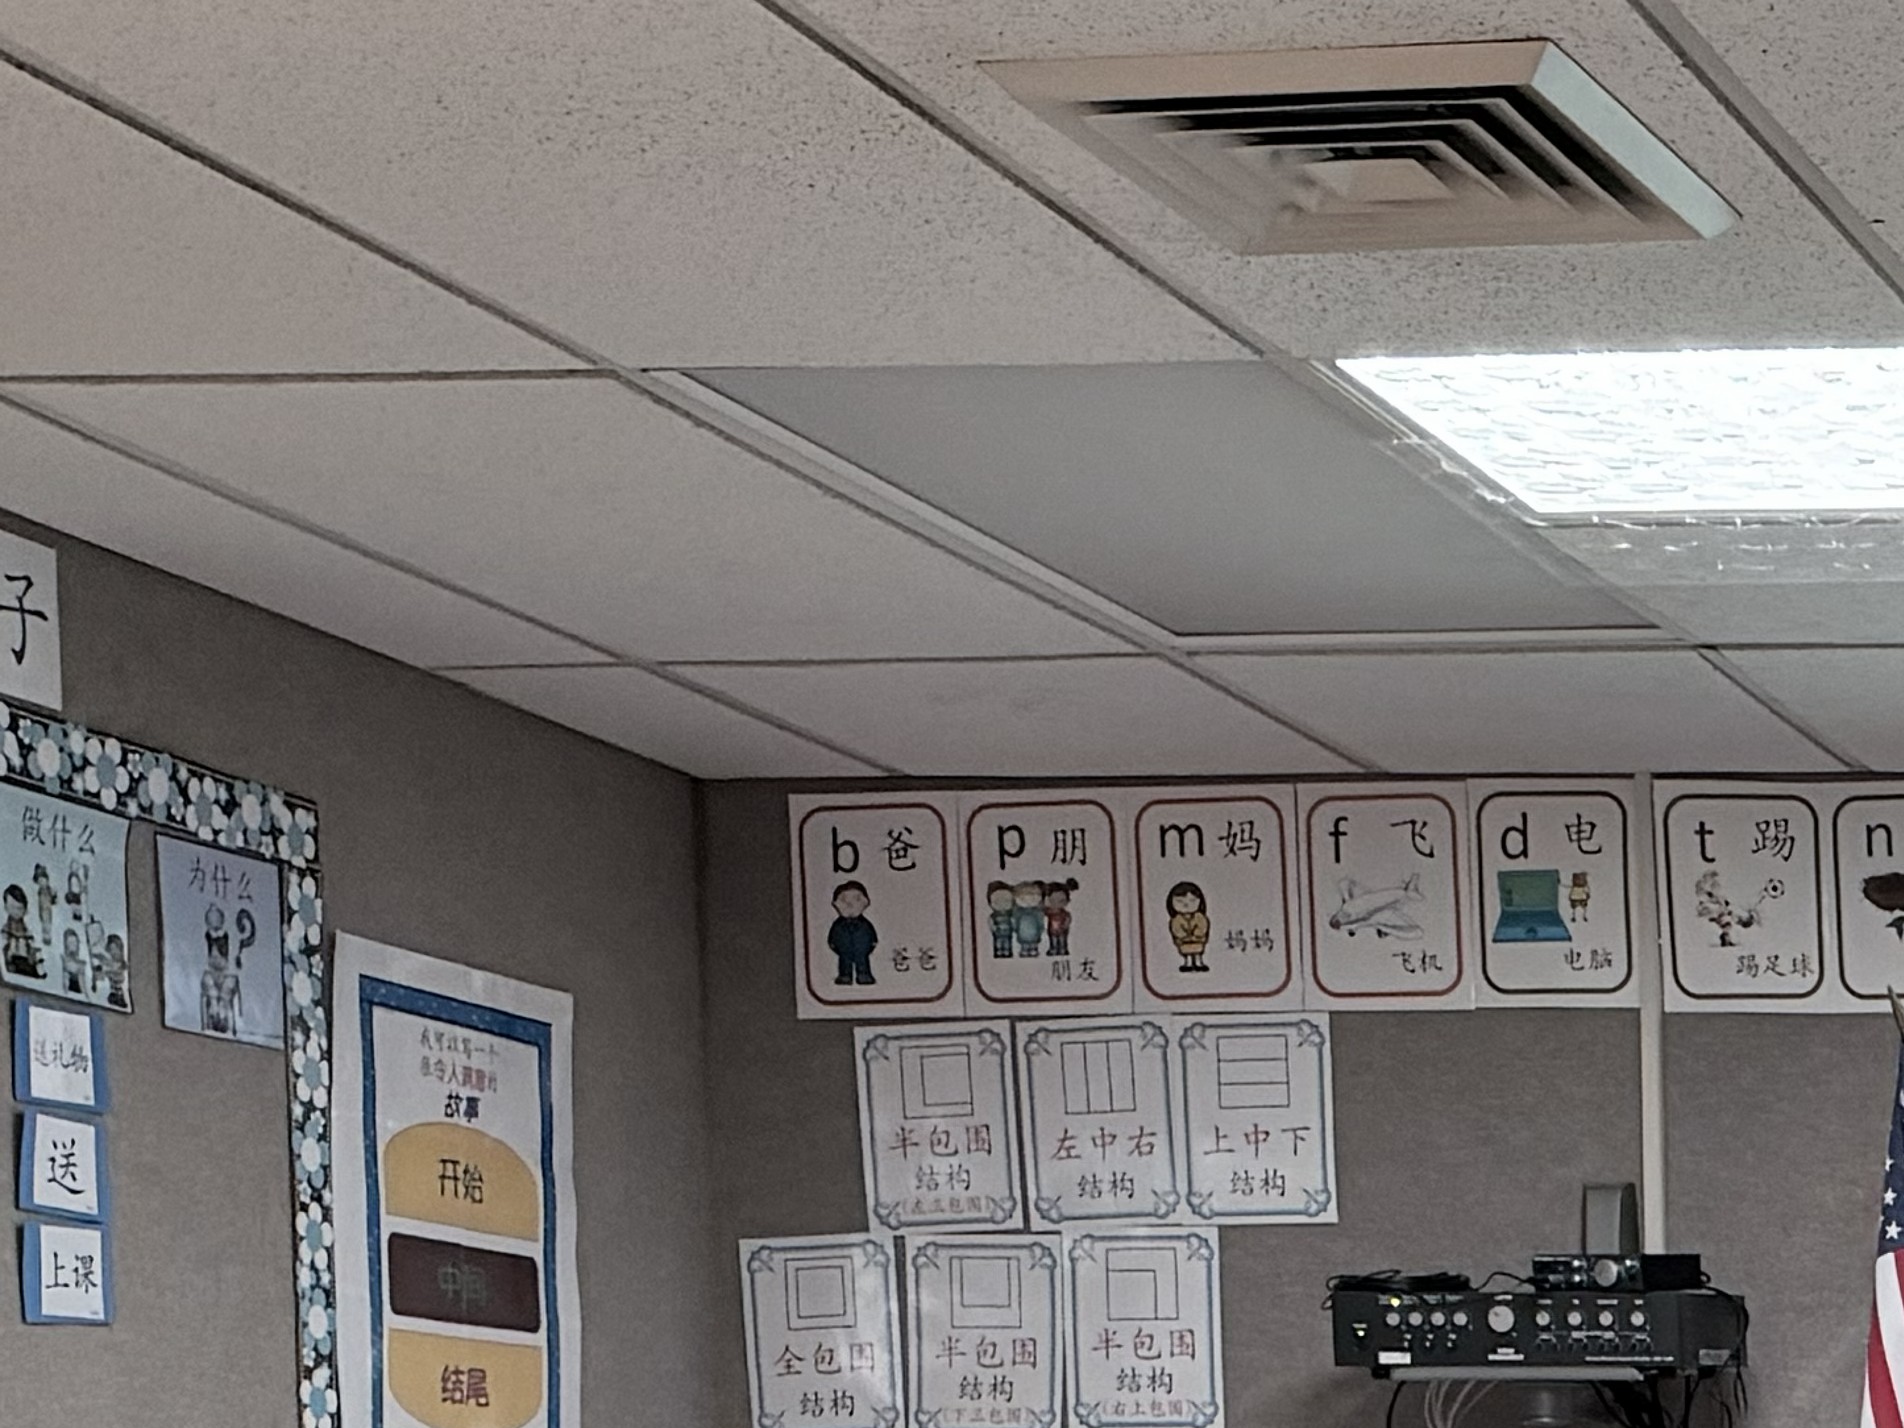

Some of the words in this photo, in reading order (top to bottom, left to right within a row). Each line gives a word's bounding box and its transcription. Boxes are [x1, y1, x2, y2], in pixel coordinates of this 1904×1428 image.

[0, 573, 49, 665] 子
[830, 826, 860, 873] b
[881, 826, 922, 873] 爸
[998, 824, 1027, 871] p
[1050, 826, 1089, 868] 朋
[1159, 822, 1203, 859] m
[1218, 818, 1264, 865] 妈
[1330, 815, 1349, 863] f
[1389, 815, 1437, 861] 飞
[1500, 812, 1527, 859] d
[1565, 810, 1602, 855] 电
[1693, 821, 1716, 863] t
[1751, 817, 1796, 863] 踢
[1866, 825, 1891, 857] n
[188, 857, 253, 903] 为什么
[889, 1124, 994, 1160] 半包围
[1051, 1126, 1159, 1163] 左中右
[1203, 1122, 1313, 1159] 上中下
[47, 1138, 85, 1195] 送
[438, 1158, 484, 1204] 开始
[914, 1164, 972, 1193] 结构
[1078, 1170, 1136, 1199] 结构
[1229, 1168, 1286, 1197] 结构
[45, 1252, 98, 1294] 上课
[773, 1341, 876, 1378] 全包围
[935, 1336, 1039, 1371] 半包围
[1091, 1327, 1198, 1362] 半包围
[440, 1364, 489, 1407] 结尾
[958, 1374, 1014, 1403] 结构
[1115, 1367, 1174, 1394] 结构
[800, 1390, 856, 1418] 结构
